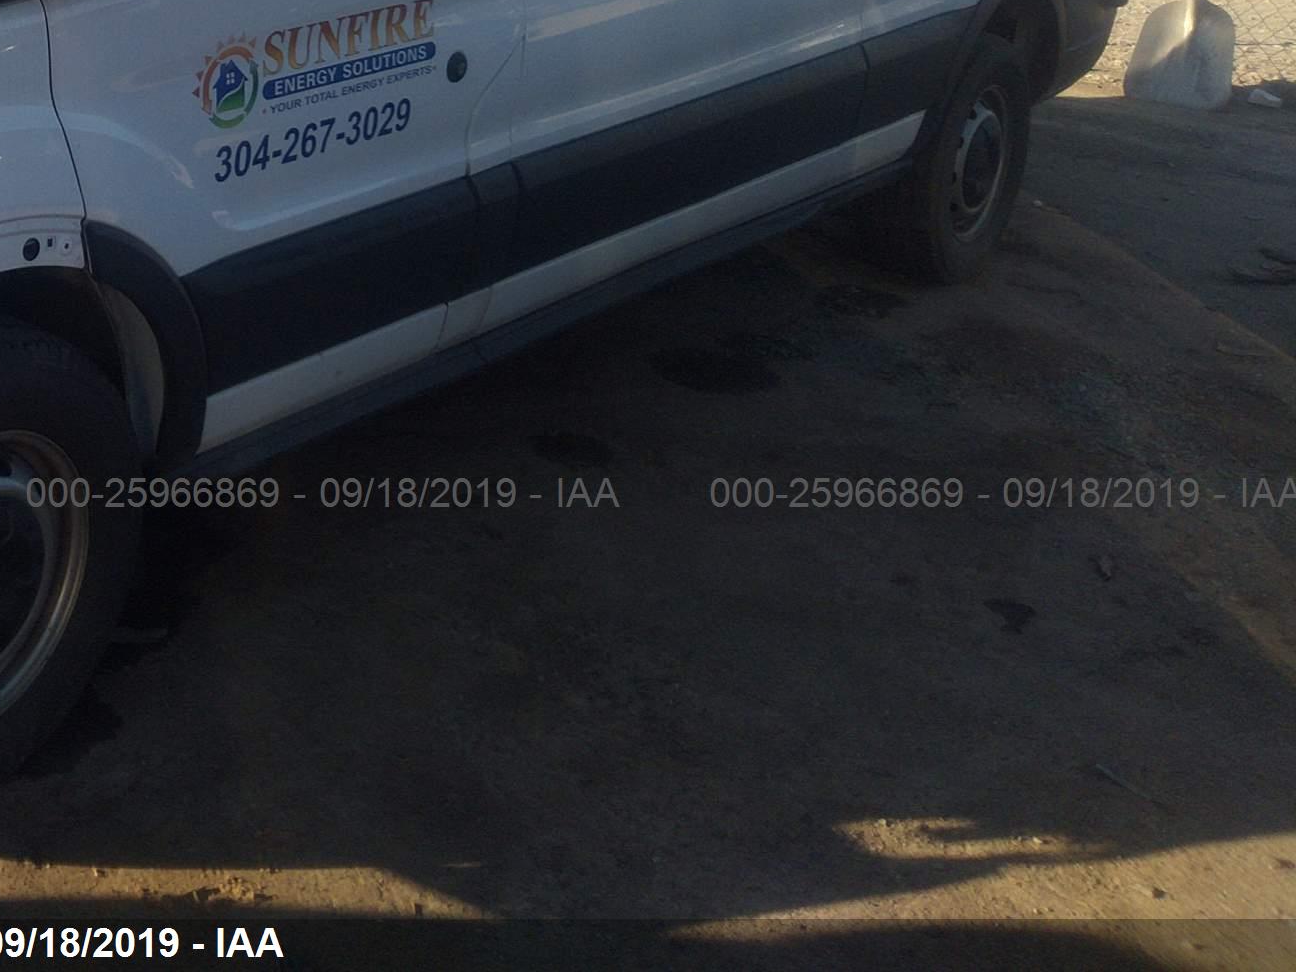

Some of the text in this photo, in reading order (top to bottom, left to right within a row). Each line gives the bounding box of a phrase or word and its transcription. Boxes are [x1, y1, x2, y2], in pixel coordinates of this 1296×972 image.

[270, 66, 433, 114] YOUR TOTAL ENERGY EXPERTS
[274, 45, 427, 96] ENERGY SOLUTIONS
[215, 98, 411, 182] 304-267-3029
